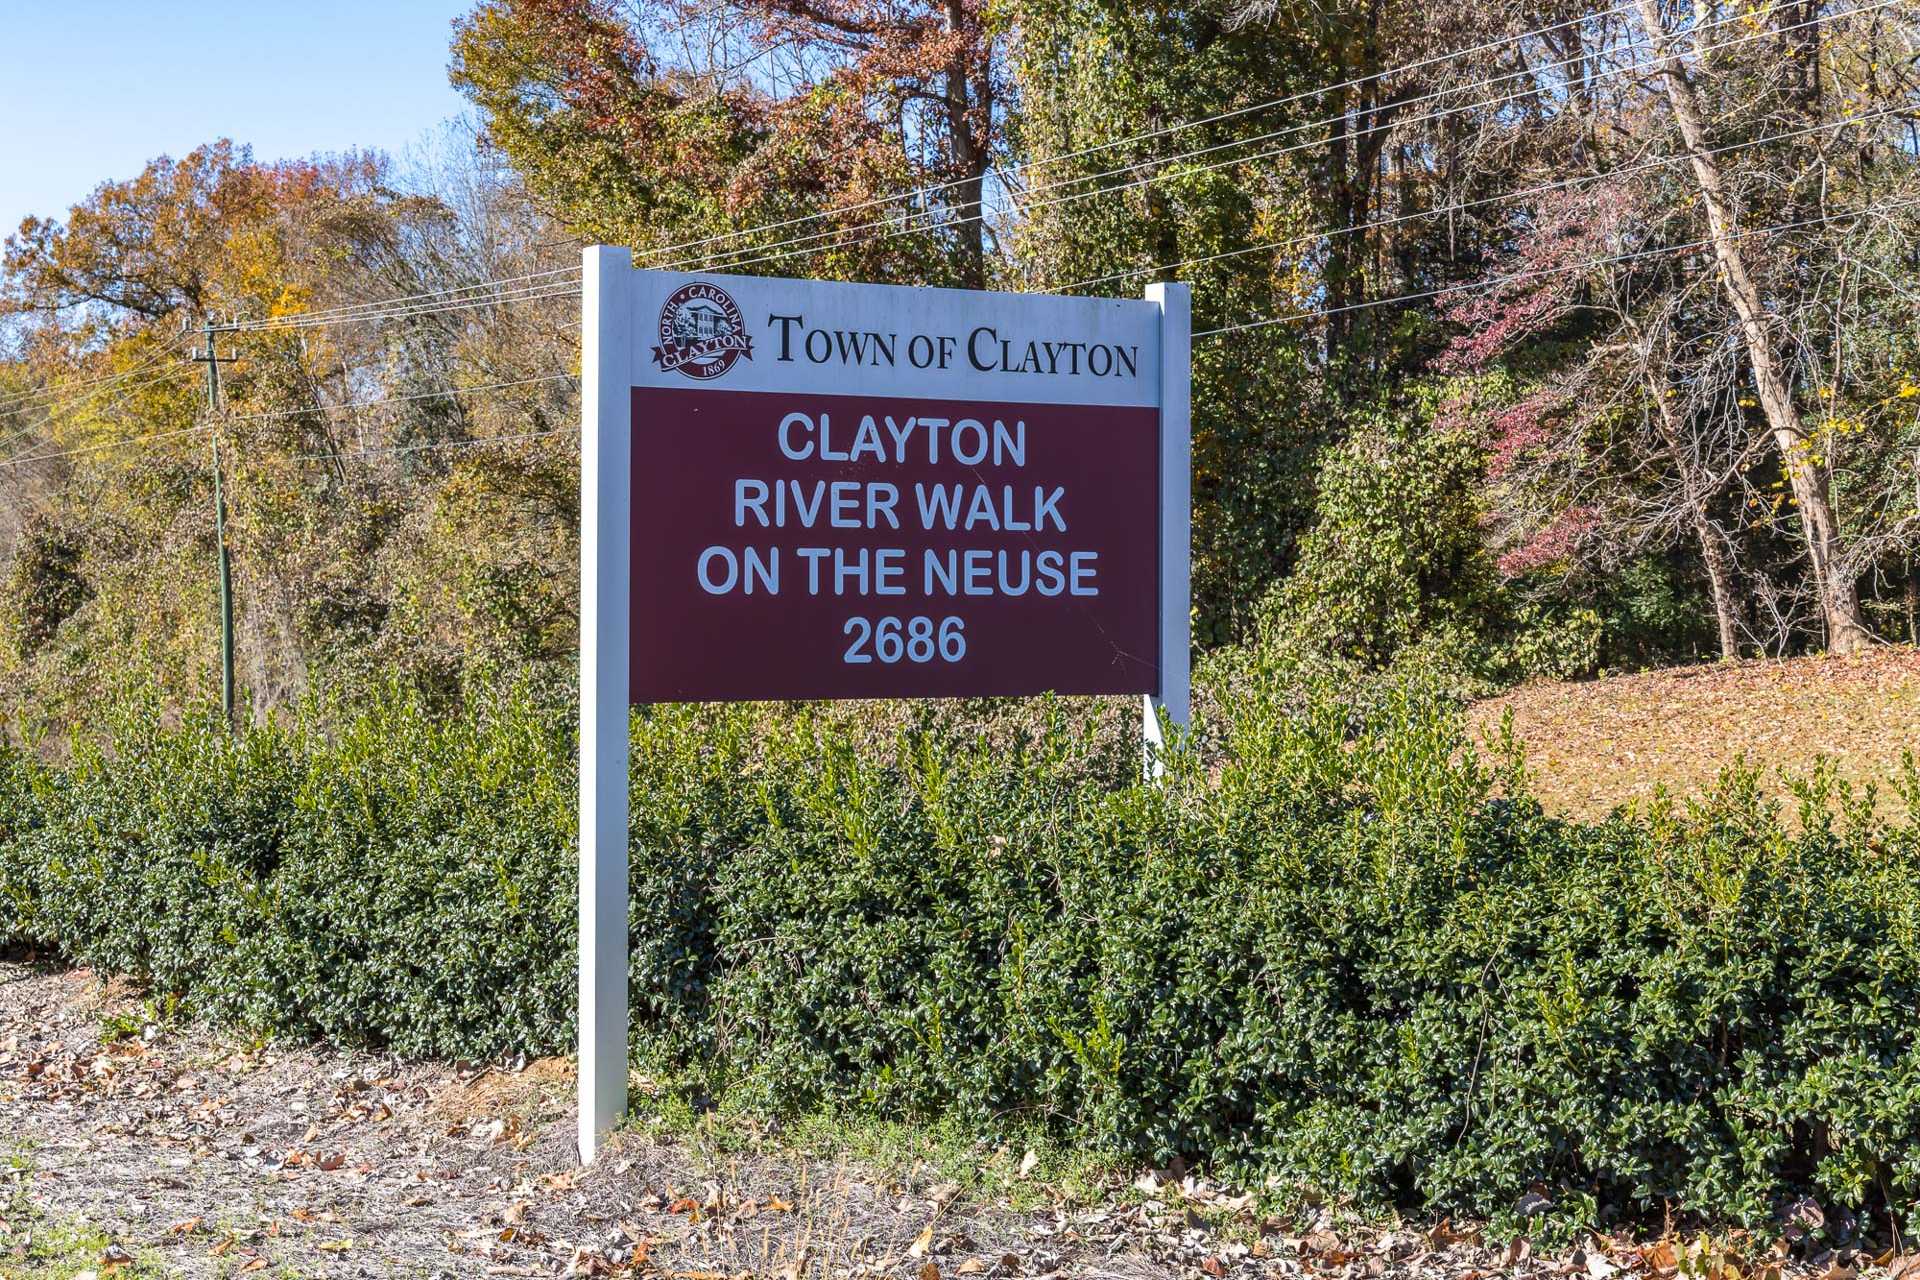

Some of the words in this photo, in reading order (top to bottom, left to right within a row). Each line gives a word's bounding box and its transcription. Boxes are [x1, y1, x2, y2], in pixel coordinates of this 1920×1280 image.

[662, 301, 679, 345] NORTH
[688, 286, 742, 333] CAROLINA
[662, 335, 748, 368] CLAYTON
[703, 359, 726, 376] 1869
[778, 412, 1025, 467] CLAYTON
[735, 479, 899, 530] RIVER
[915, 482, 1066, 532] WALK
[697, 545, 779, 595] ON
[796, 547, 905, 595] THE
[924, 549, 1098, 597] NEUSE
[843, 616, 966, 664] 2686
